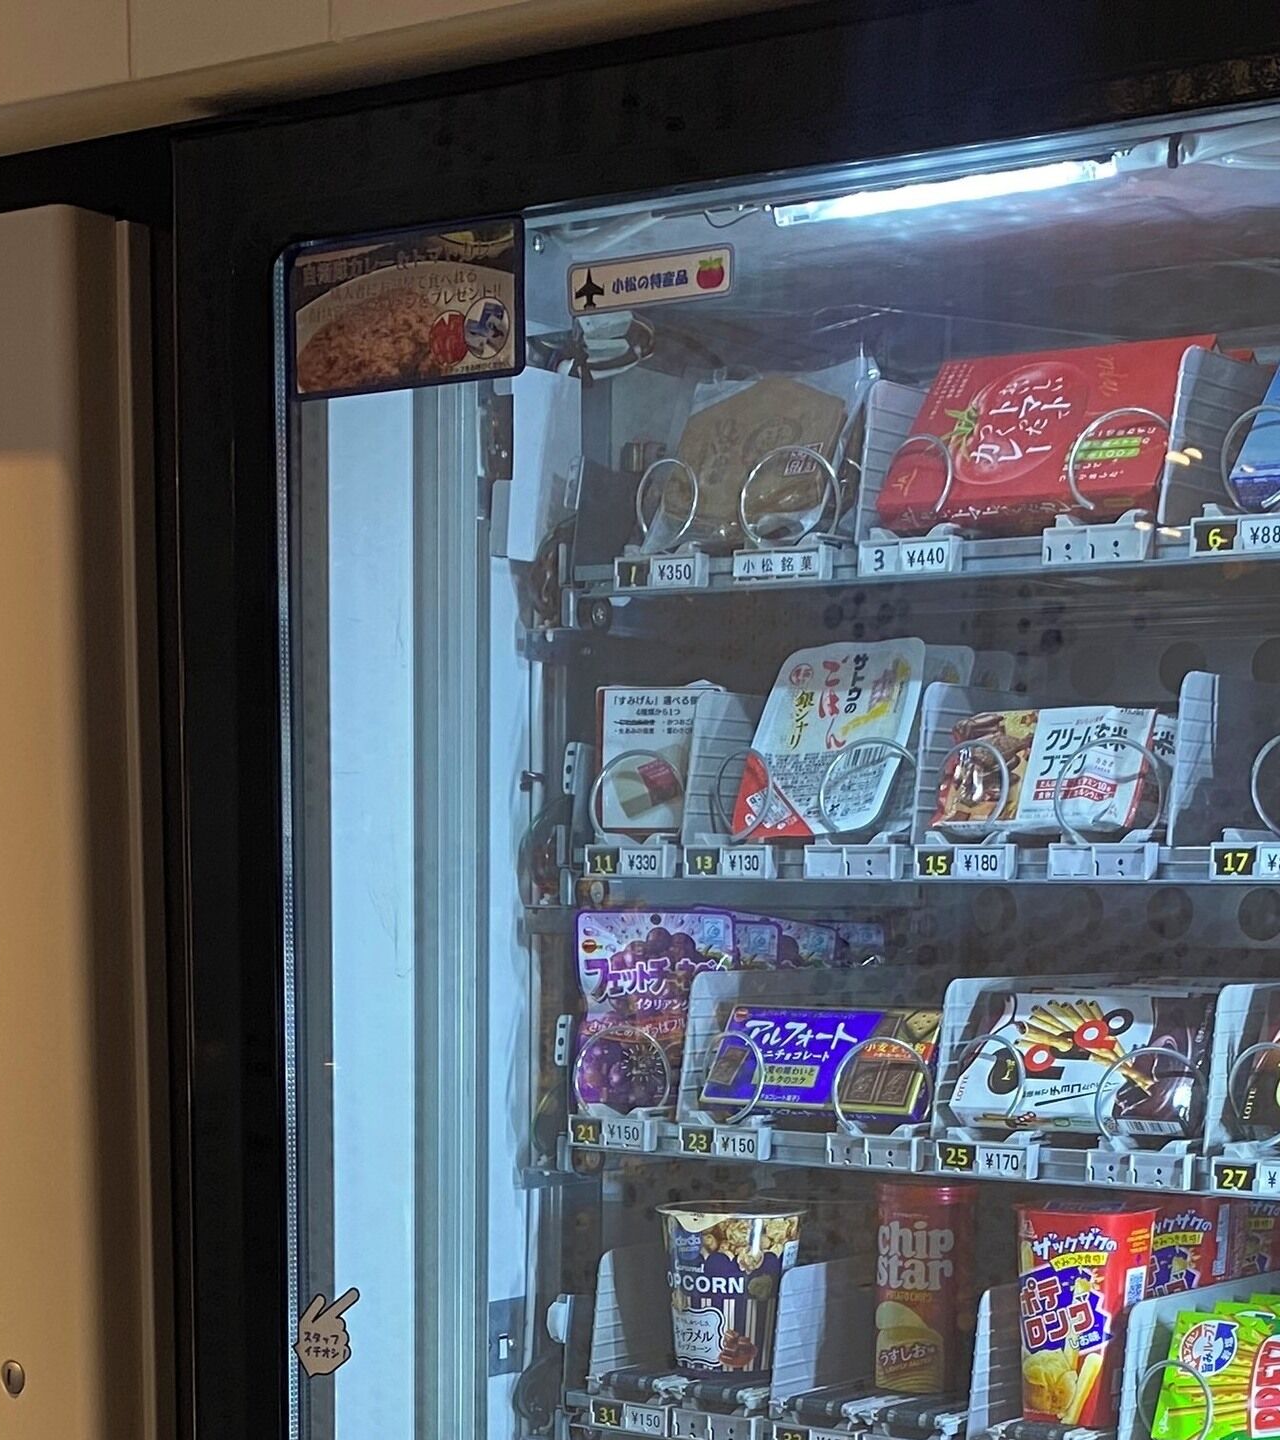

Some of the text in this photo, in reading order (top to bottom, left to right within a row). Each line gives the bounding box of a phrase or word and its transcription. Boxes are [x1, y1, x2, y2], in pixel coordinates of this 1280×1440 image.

[612, 269, 688, 293] 小松の特産品
[743, 553, 813, 573] 小松銘菓
[907, 546, 945, 567] ¥440
[657, 561, 691, 582] ¥350
[844, 653, 868, 713] サトウの
[595, 854, 759, 871] 11 ¥330 ¥130
[926, 856, 947, 872] 15
[964, 854, 998, 871] ¥180
[1223, 854, 1248, 871] 17
[744, 1020, 858, 1048] アルフォート
[577, 1125, 754, 1153] 21 ¥150 23 ¥150
[946, 1148, 968, 1166] 25
[986, 1153, 1019, 1170] ¥170
[1222, 1170, 1248, 1187] 27
[878, 1221, 954, 1260] chip
[1032, 1228, 1117, 1260] ザックザクの
[877, 1254, 954, 1291] star
[304, 1331, 339, 1345] スタッフ
[631, 1412, 659, 1427] ¥150
